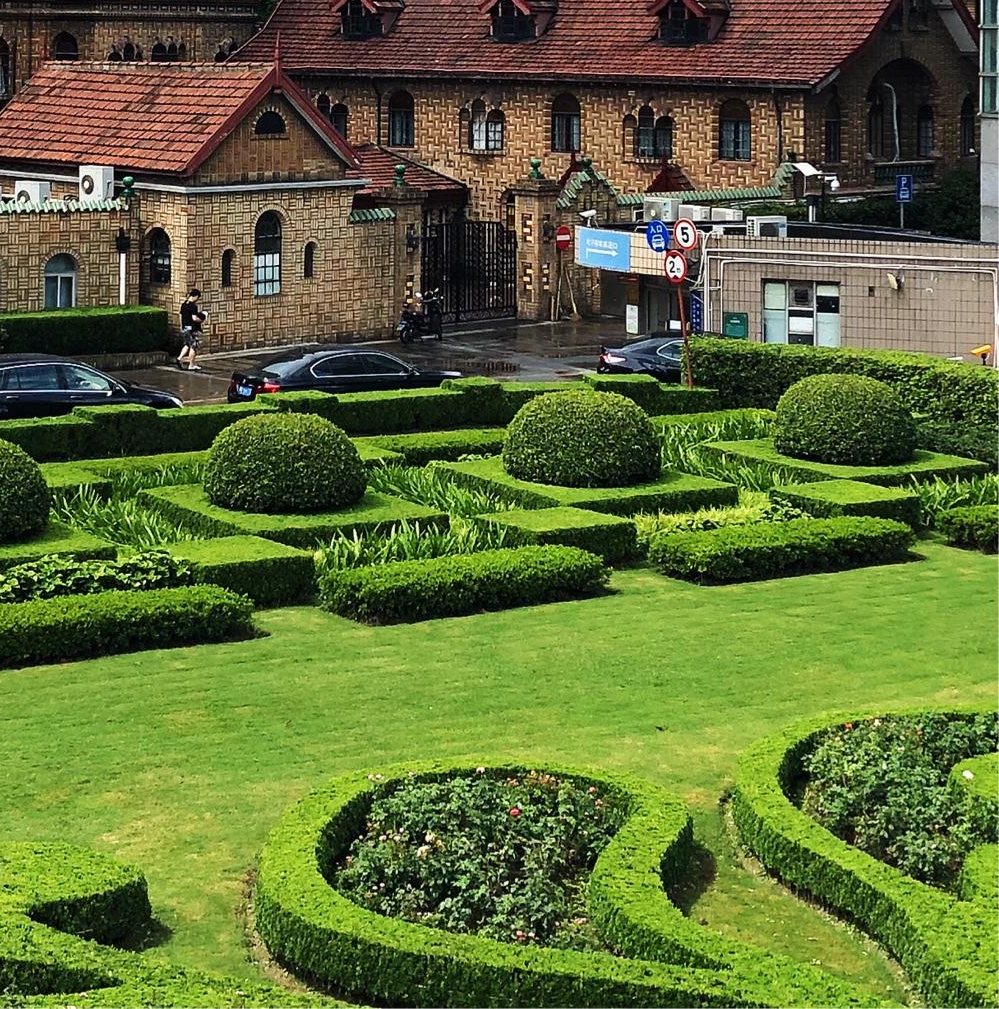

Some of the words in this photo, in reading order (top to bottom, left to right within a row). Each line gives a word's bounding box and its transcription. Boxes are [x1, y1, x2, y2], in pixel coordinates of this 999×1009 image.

[901, 177, 908, 188] P
[650, 224, 663, 233] 入口
[680, 226, 690, 243] 5
